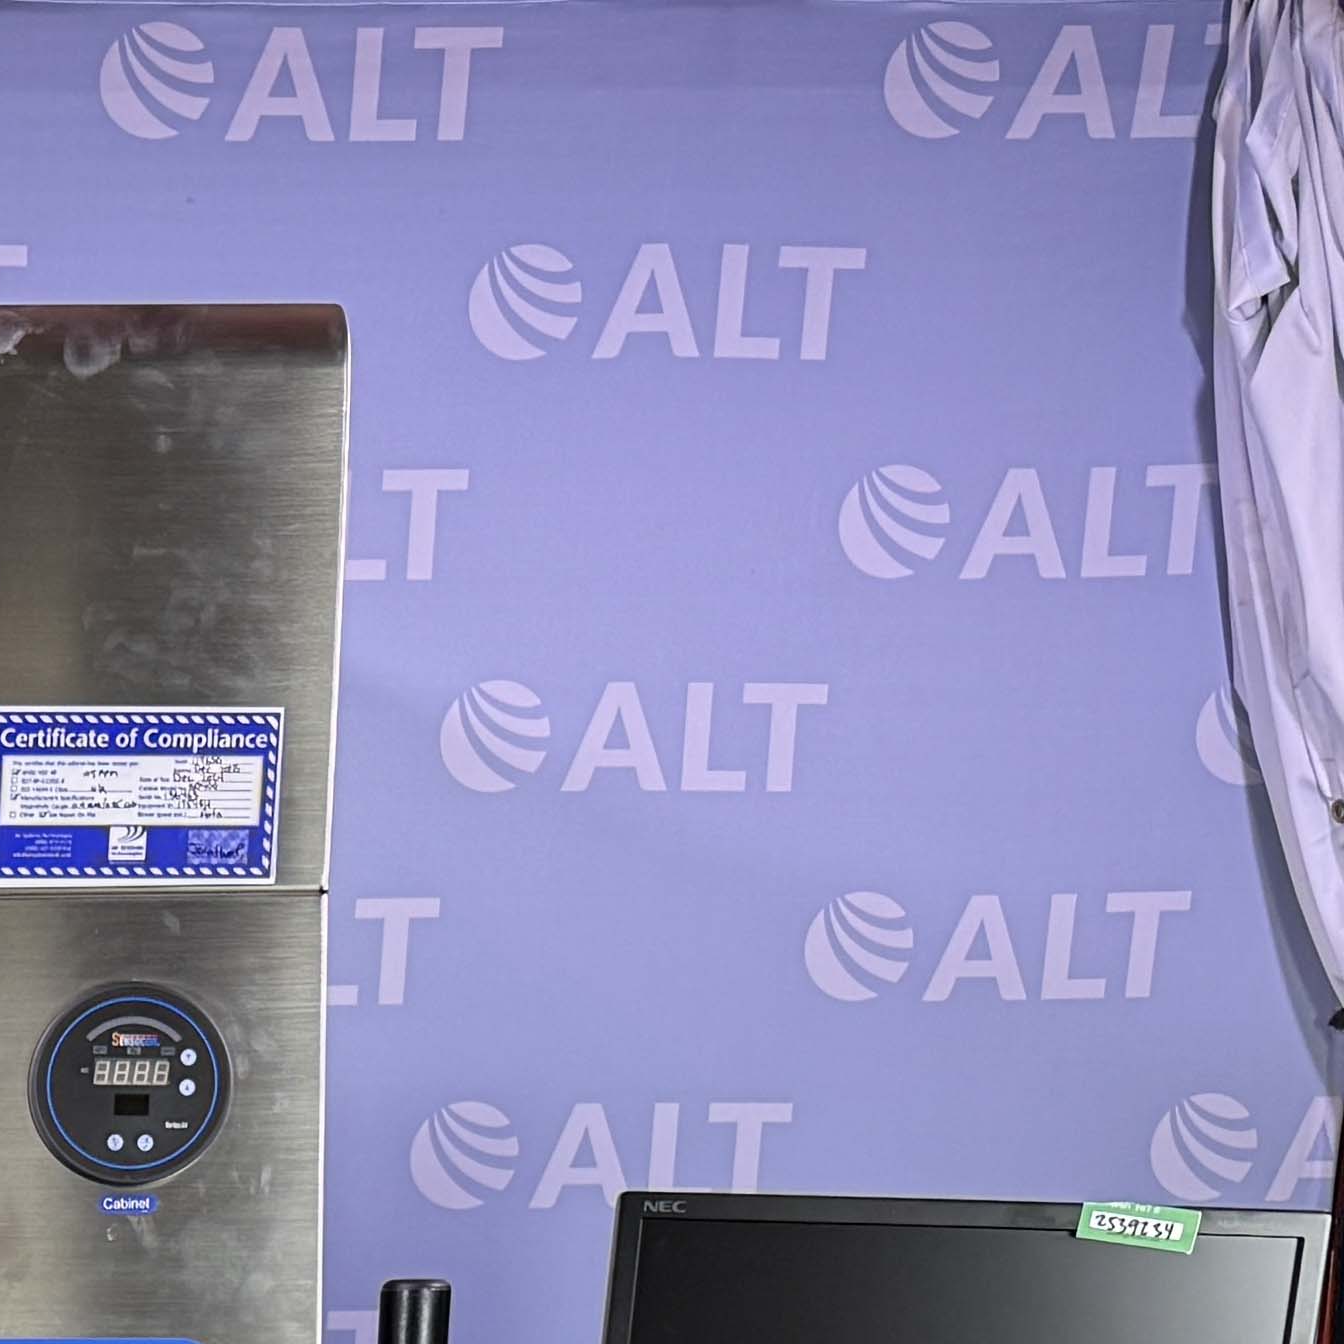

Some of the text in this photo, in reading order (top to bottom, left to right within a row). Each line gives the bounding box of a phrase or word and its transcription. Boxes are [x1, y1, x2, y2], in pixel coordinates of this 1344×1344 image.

[225, 27, 504, 142] ALT
[1005, 24, 1226, 140] AL
[592, 244, 866, 360] ALT
[959, 465, 1216, 580] ALT
[0, 728, 269, 753] Certificate of Compliance
[562, 682, 829, 792] ALT
[923, 891, 1192, 1001] ALT
[103, 1197, 150, 1211] Cabinet
[643, 1200, 688, 1213] NEC
